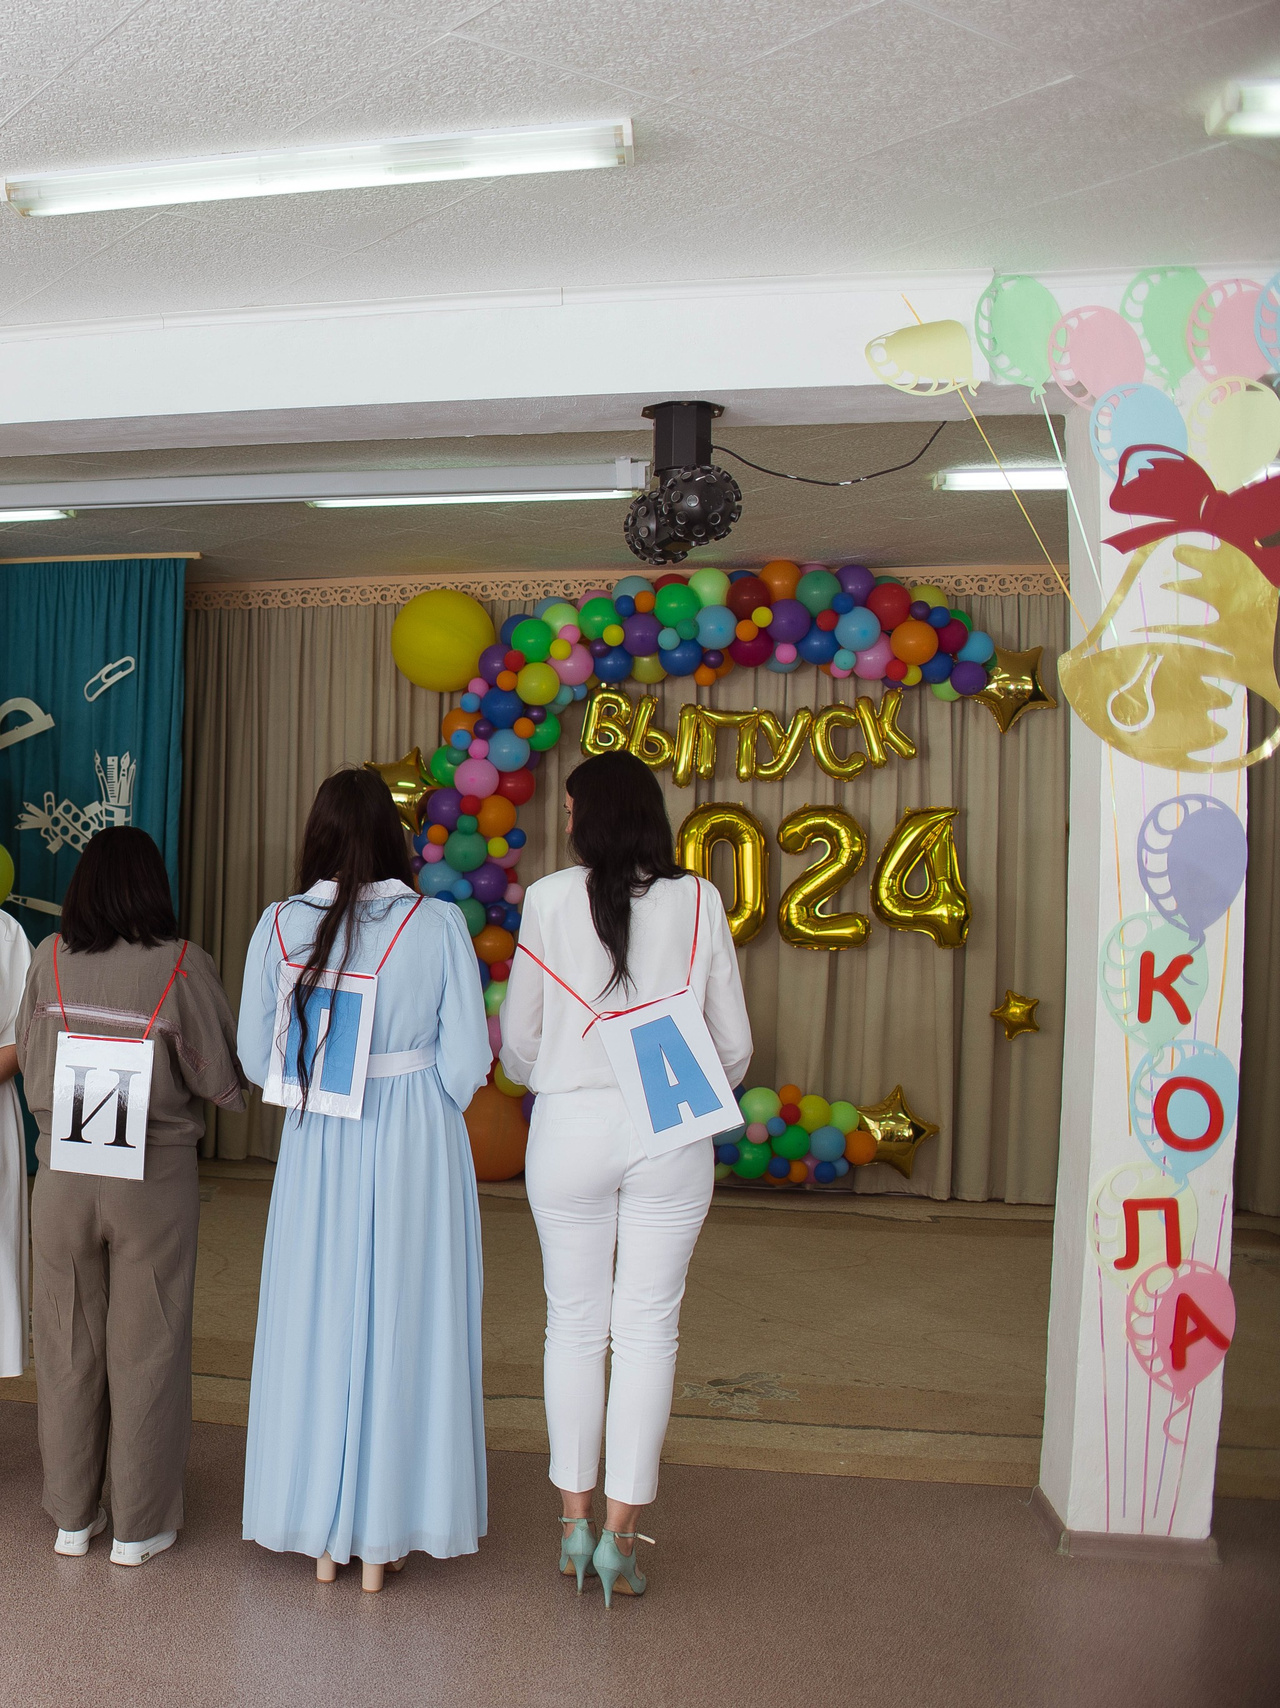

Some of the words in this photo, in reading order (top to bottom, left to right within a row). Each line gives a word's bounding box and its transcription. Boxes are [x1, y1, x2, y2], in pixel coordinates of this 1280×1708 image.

[580, 686, 918, 788] ВЫПУСК
[60, 1065, 141, 1149] И
[629, 1014, 723, 1134] А
